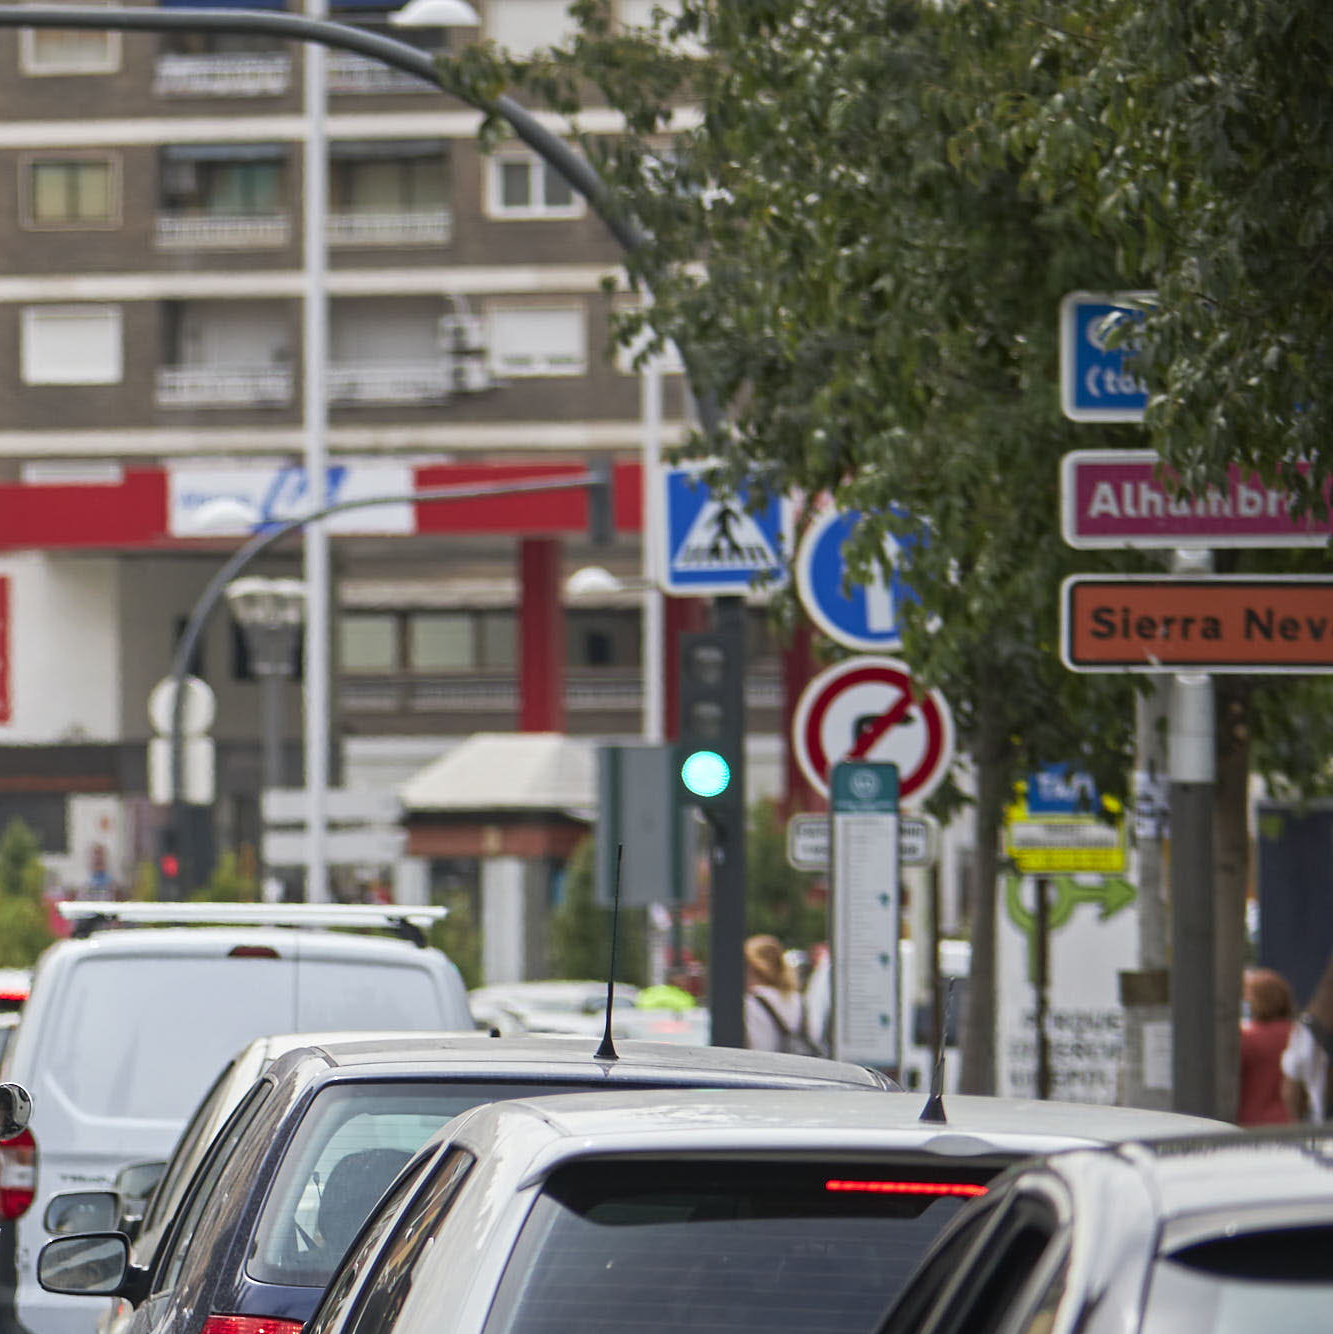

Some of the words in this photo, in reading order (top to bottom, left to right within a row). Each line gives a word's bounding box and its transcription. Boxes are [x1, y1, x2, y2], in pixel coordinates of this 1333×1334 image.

[1089, 481, 1299, 518] Alhambr
[1089, 606, 1223, 641] Sierra
[1243, 607, 1333, 641] Nev
